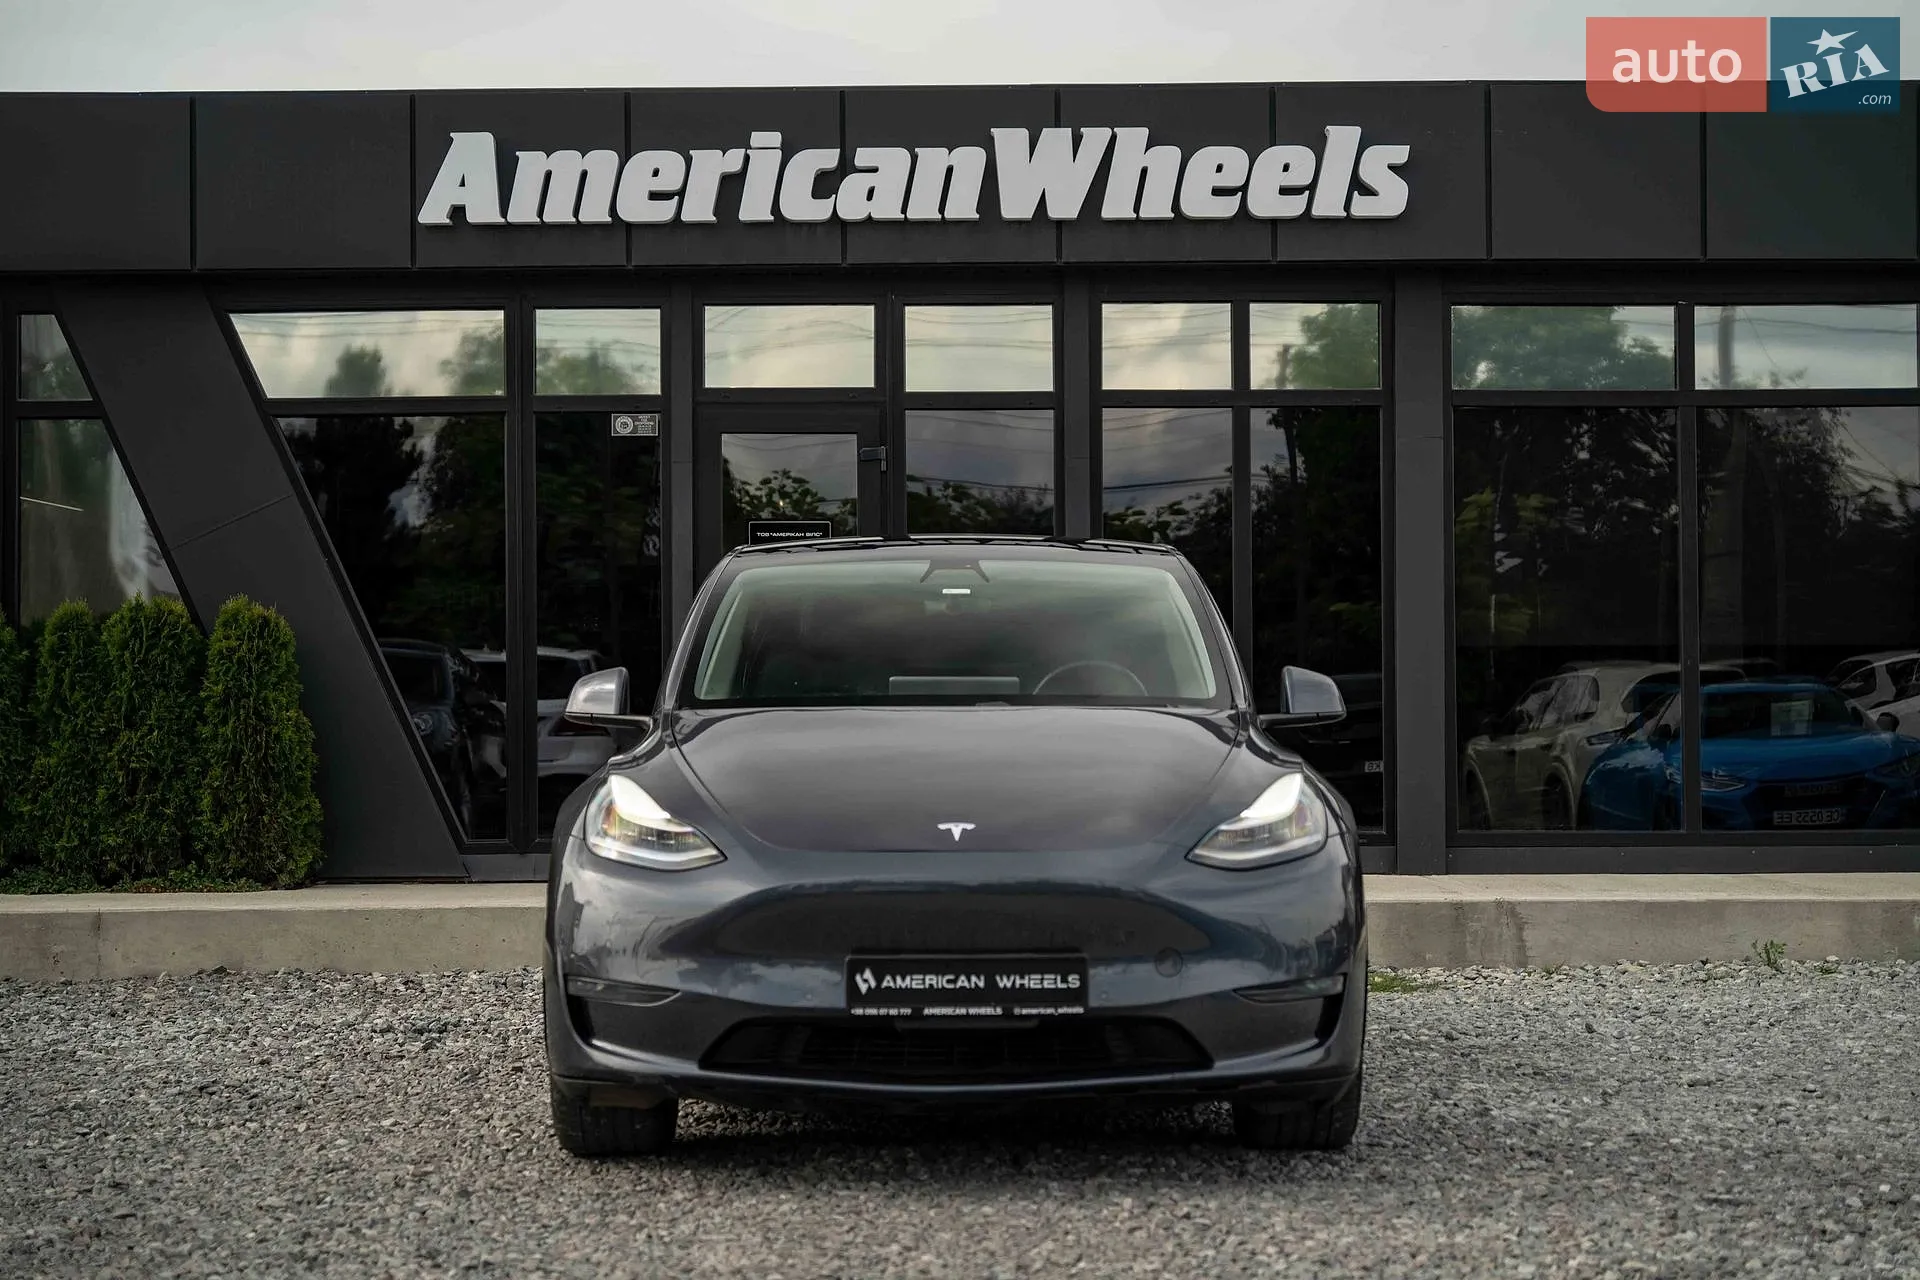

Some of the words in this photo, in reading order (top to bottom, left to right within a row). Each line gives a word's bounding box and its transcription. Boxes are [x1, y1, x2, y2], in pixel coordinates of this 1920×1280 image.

[417, 125, 1411, 225] AmericanWheels
[881, 974, 985, 989] AMERICAN
[995, 973, 1081, 988] WHEELS
[923, 1007, 967, 1016] AMERICAN
[968, 1006, 1003, 1015] WHEELS
